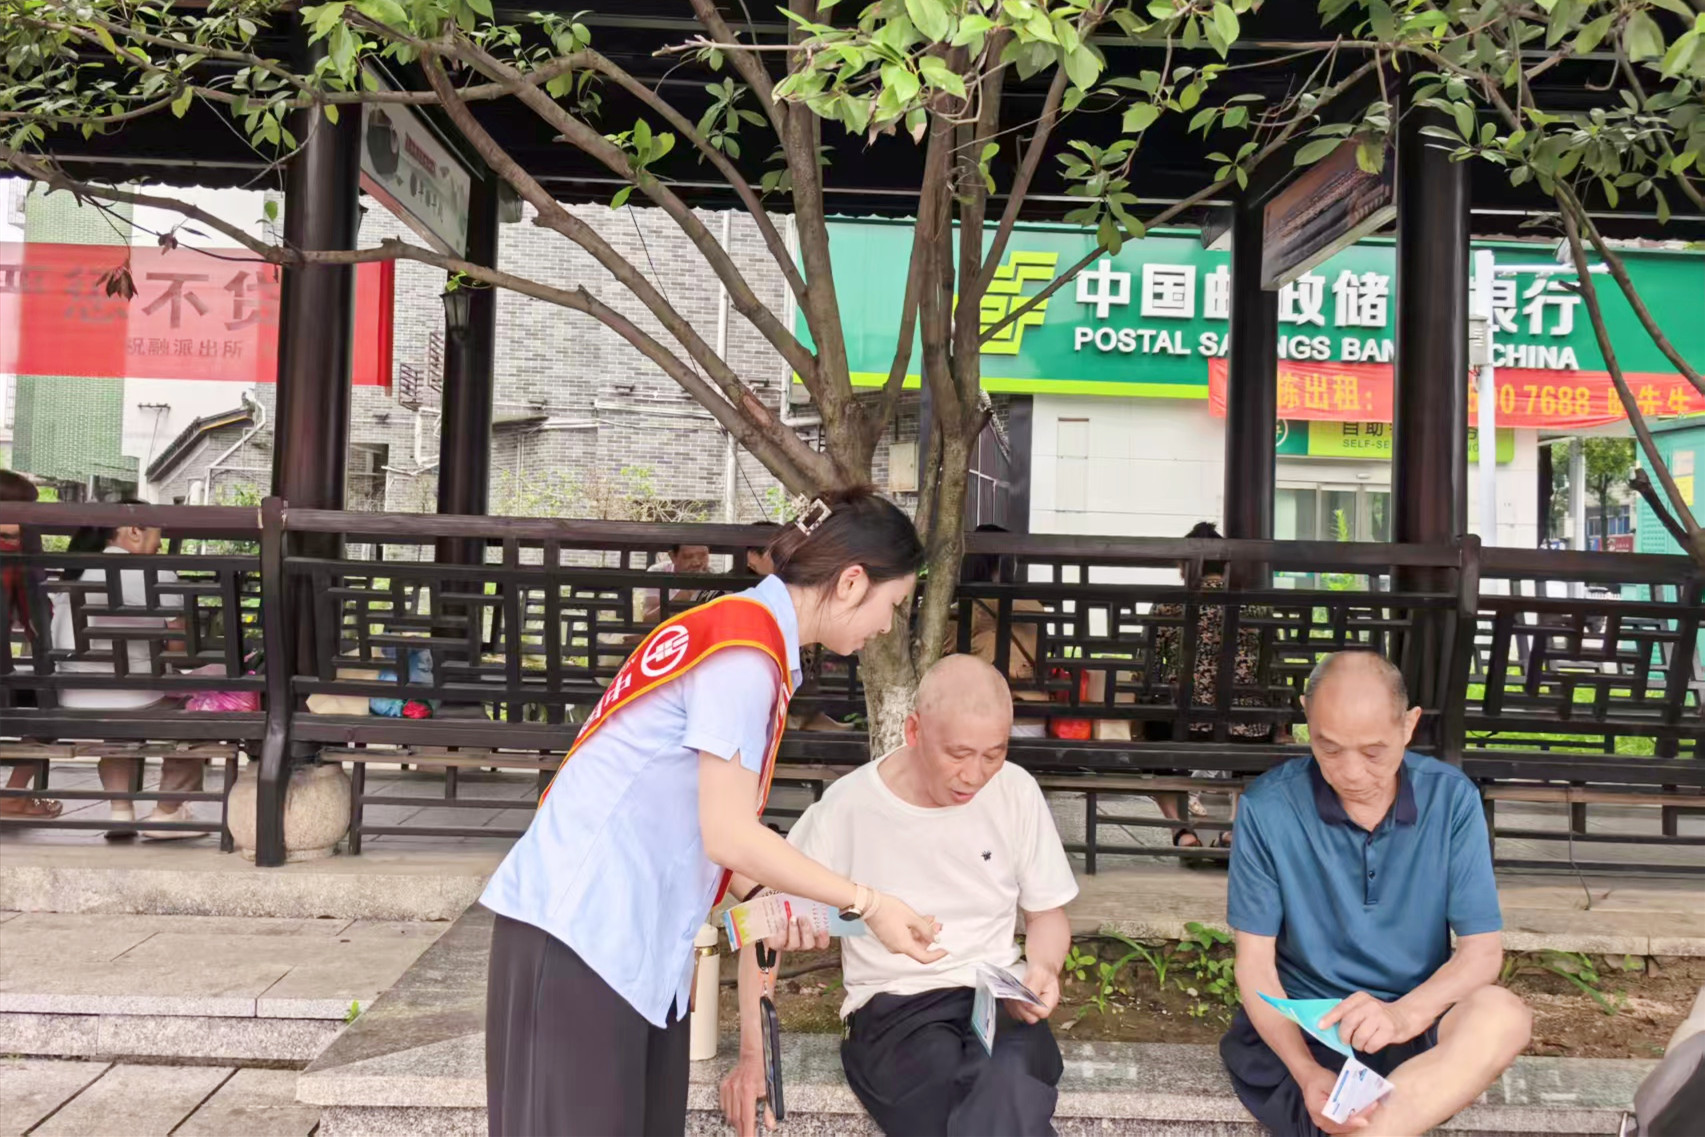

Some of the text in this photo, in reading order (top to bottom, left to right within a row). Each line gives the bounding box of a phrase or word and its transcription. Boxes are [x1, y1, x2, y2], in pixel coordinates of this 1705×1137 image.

[1074, 327, 1192, 355] POSTAL
[1341, 336, 1395, 362] BAN
[1493, 343, 1580, 370] CHINA
[1523, 384, 1592, 417] 7688
[1342, 421, 1391, 437] 自助
[1342, 439, 1390, 450] SELF-SE
